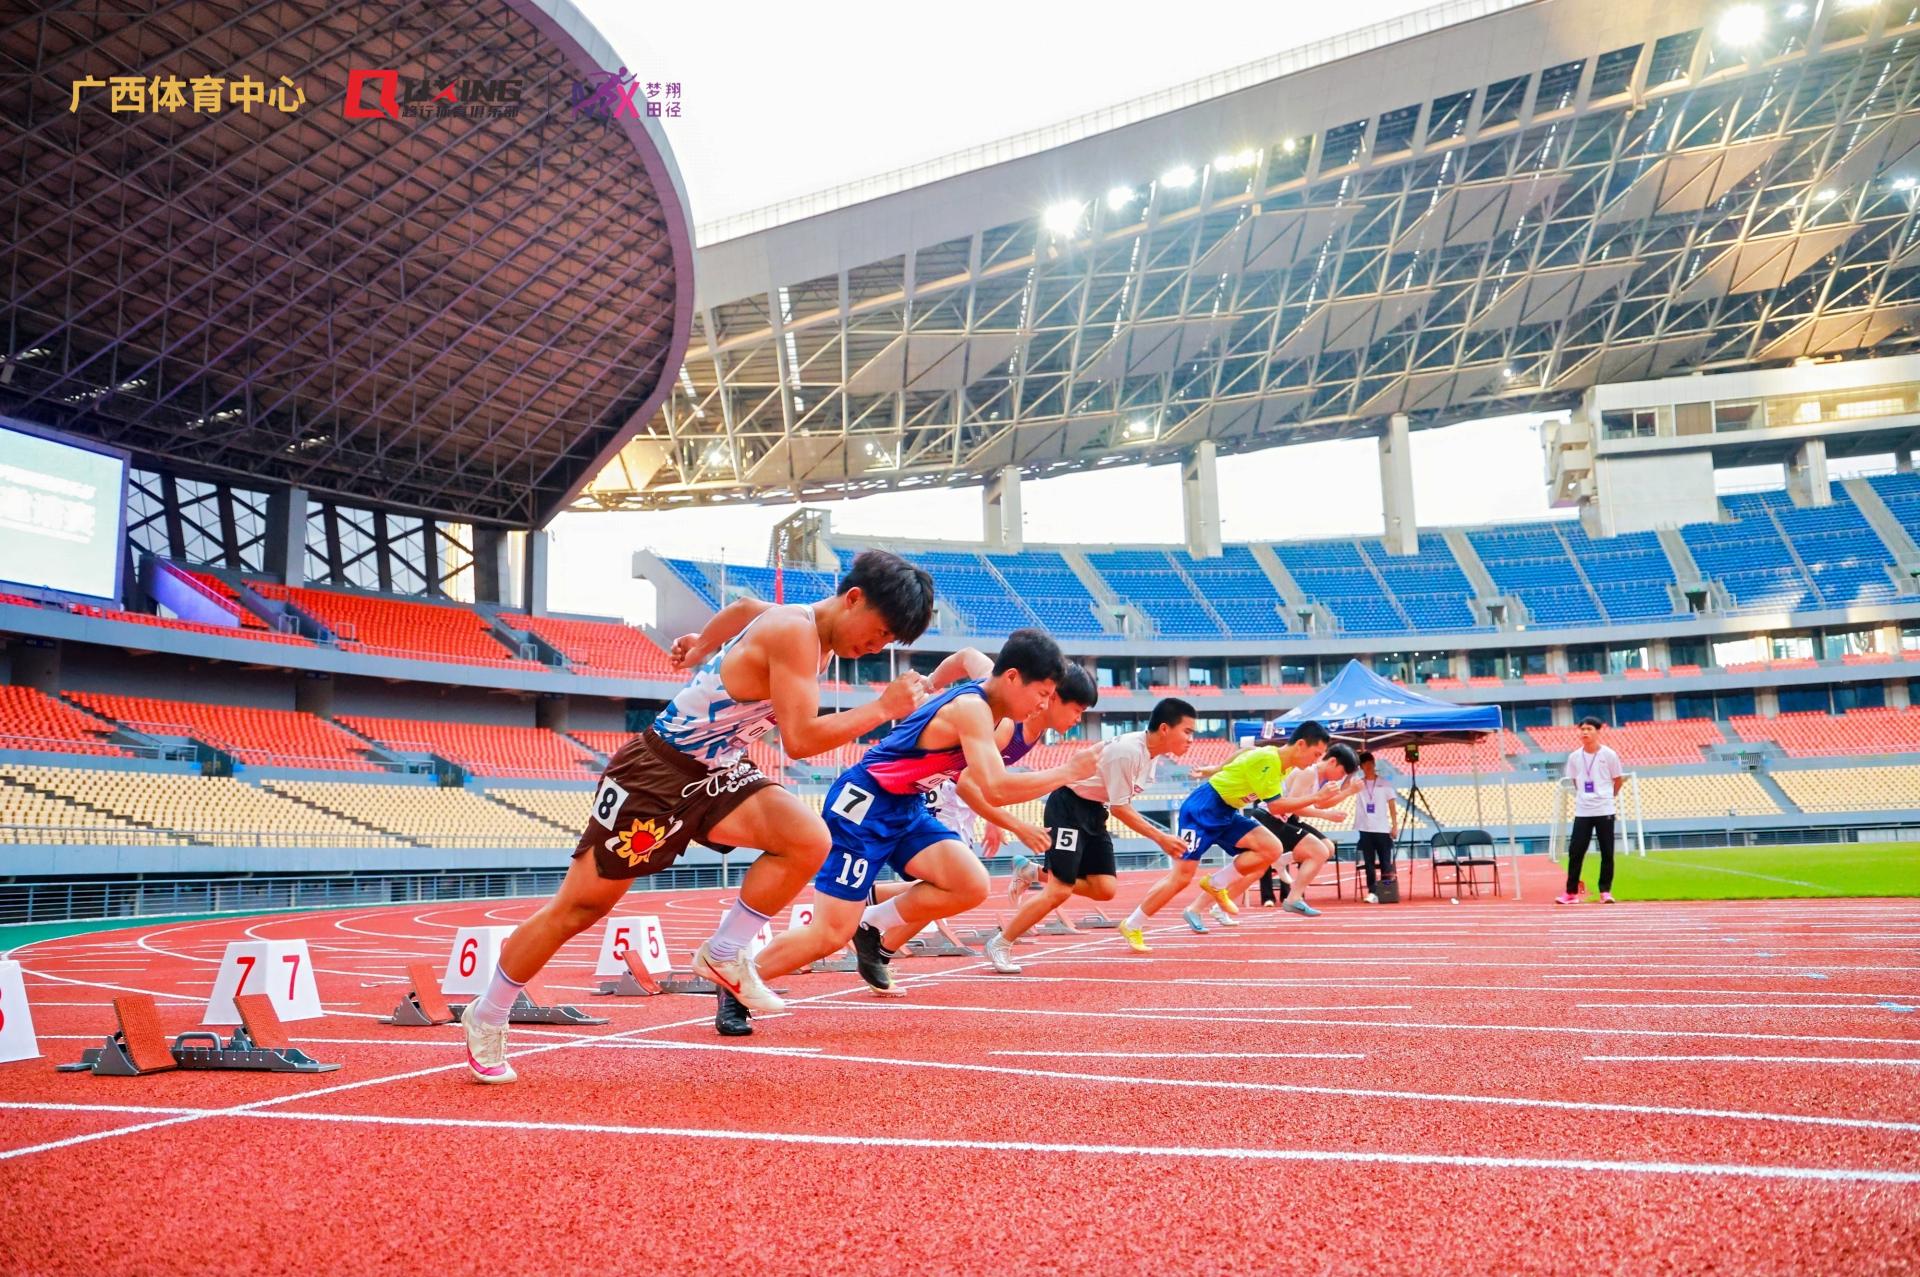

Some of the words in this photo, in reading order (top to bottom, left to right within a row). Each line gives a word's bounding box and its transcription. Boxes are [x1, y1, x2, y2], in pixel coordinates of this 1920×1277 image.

[598, 787, 618, 820] 8
[843, 787, 868, 814] 7
[1060, 830, 1073, 847] 5
[1183, 831, 1193, 845] 4
[835, 852, 869, 889] 19
[459, 938, 479, 978] 6
[613, 928, 630, 961] 5
[647, 926, 660, 959] 5
[235, 956, 256, 997] 7
[282, 954, 300, 1001] 7
